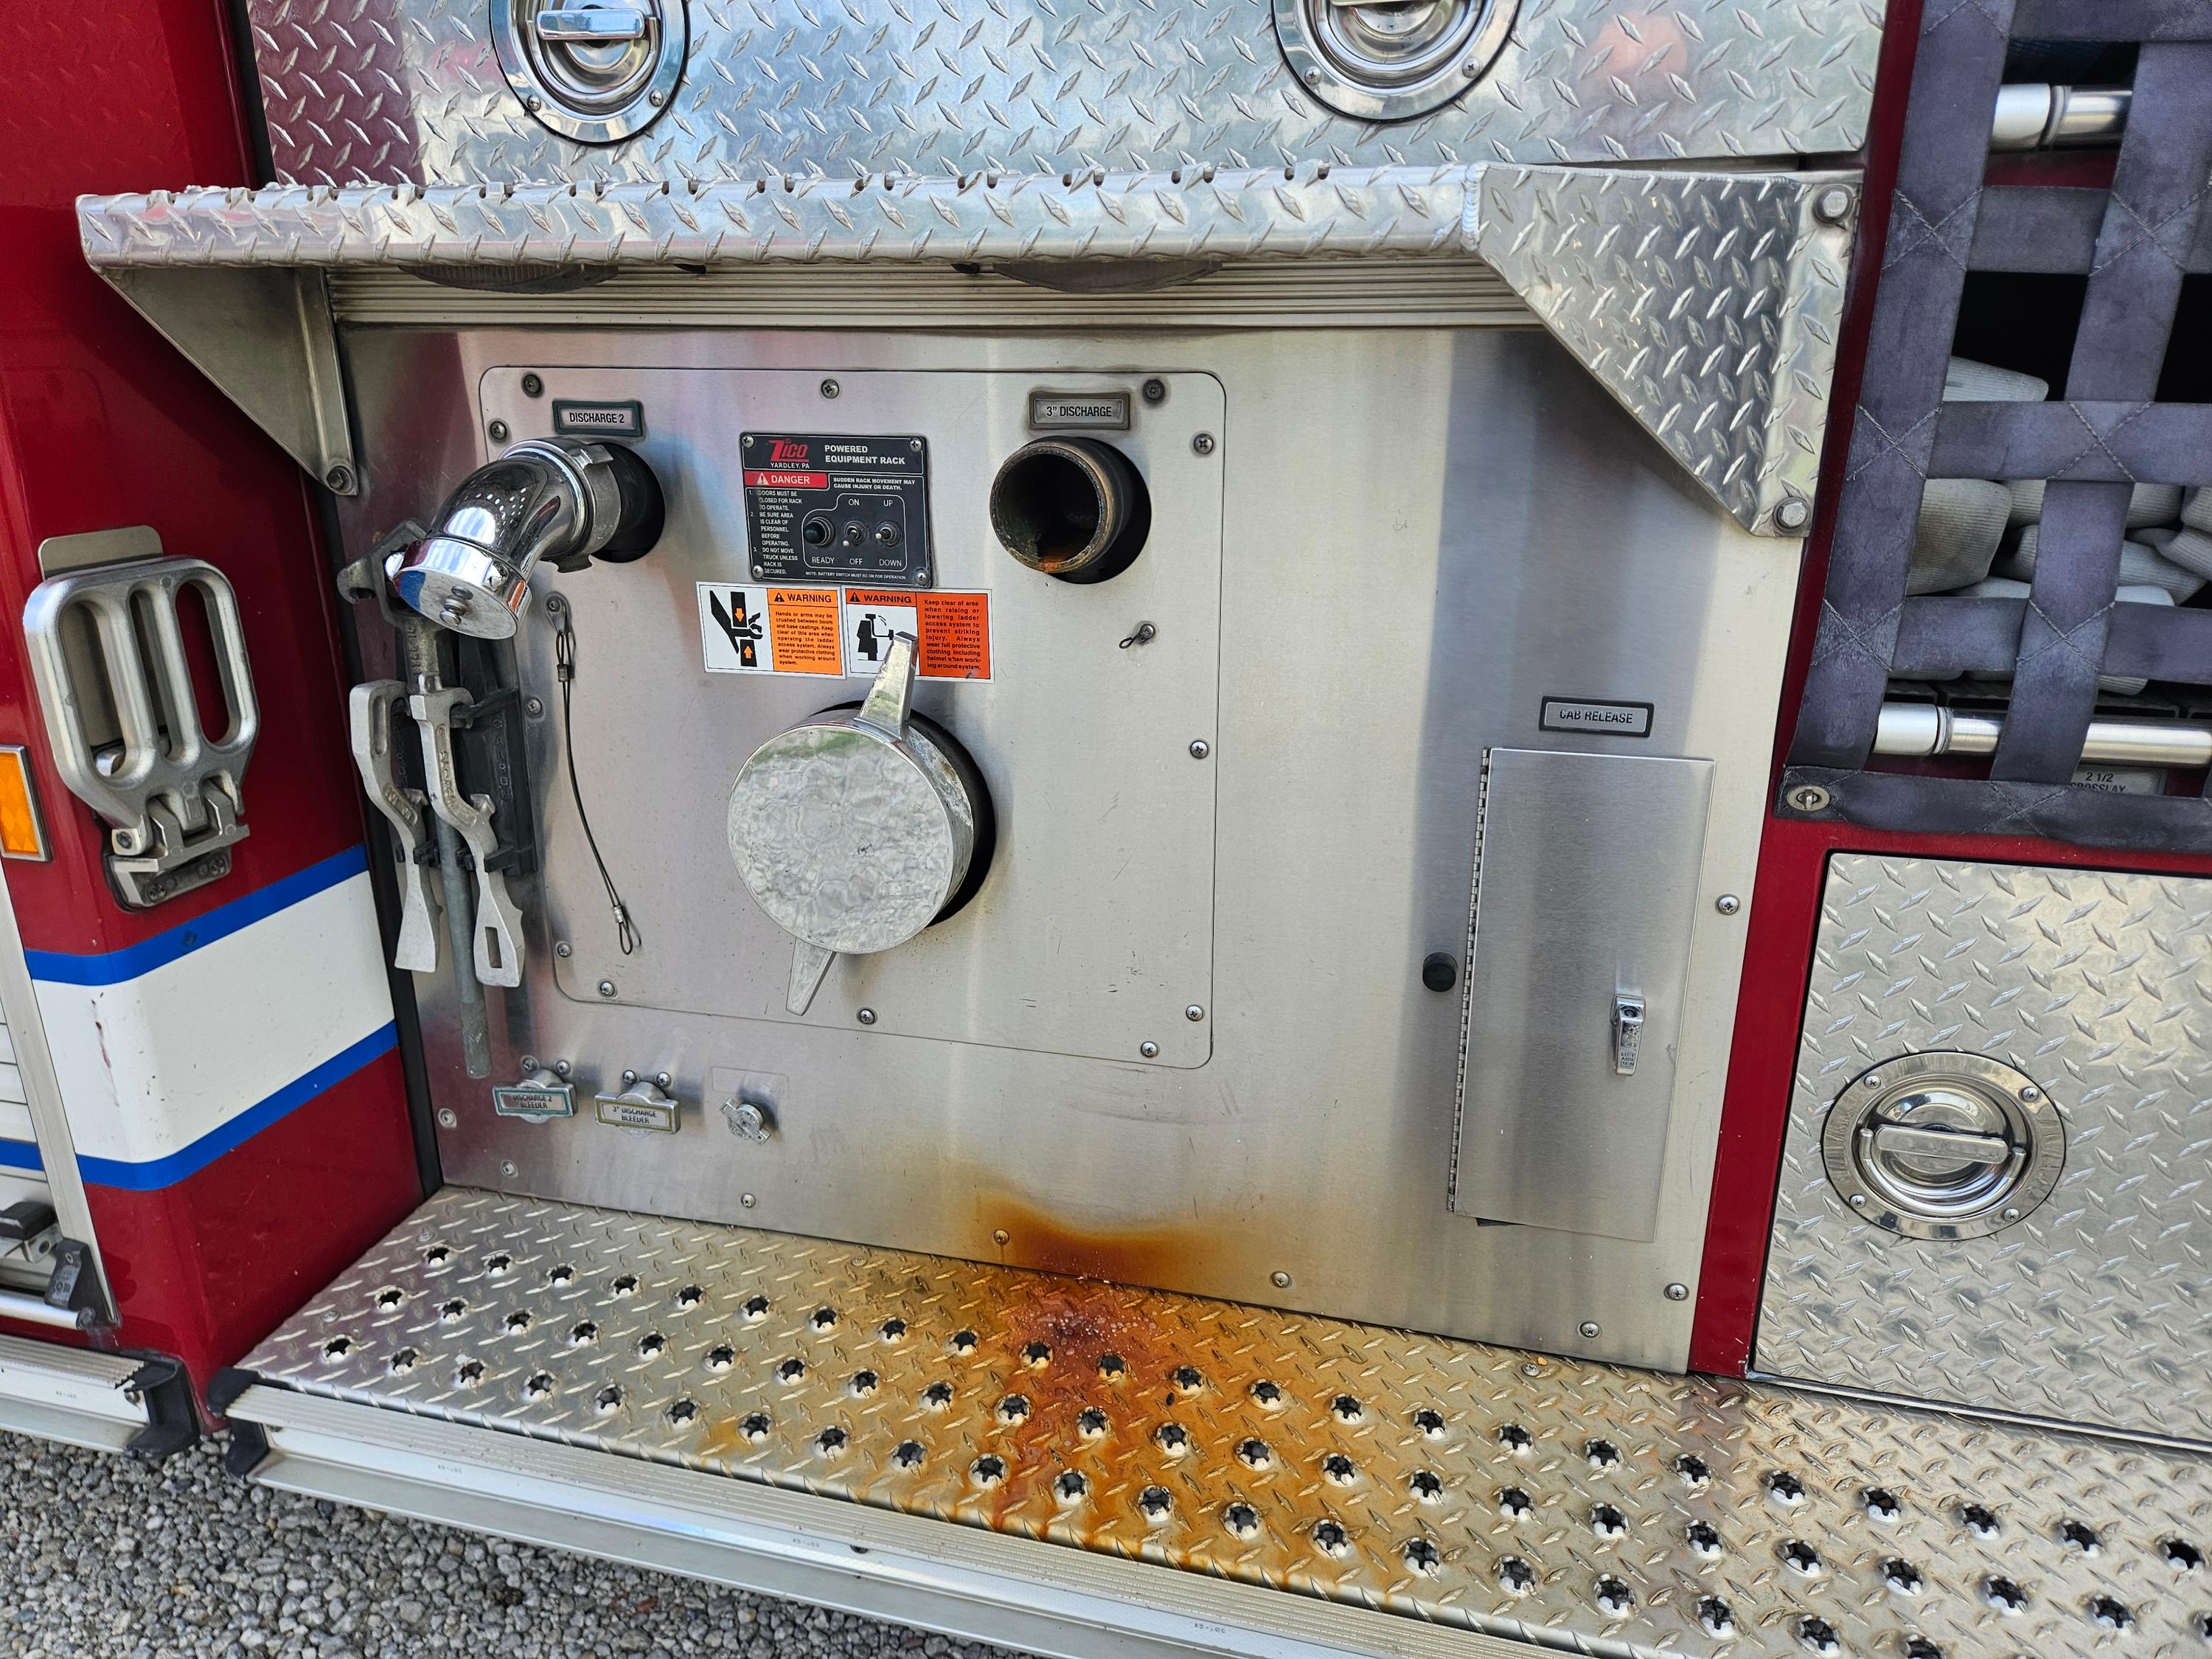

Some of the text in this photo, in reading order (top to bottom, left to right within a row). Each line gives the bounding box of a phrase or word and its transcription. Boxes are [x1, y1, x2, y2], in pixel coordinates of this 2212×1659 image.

[1060, 406, 1112, 417] DISCHARGE
[569, 412, 625, 423] DISCHARGE 2
[824, 445, 869, 453] POWERED
[825, 455, 905, 465] EQUIPMENT RACK
[771, 475, 810, 484] DANGER
[848, 498, 860, 507] ON
[812, 556, 835, 564] READY
[879, 559, 902, 567] DOWN
[787, 594, 832, 603] WARNING
[863, 594, 911, 603] WARNING
[1559, 709, 1633, 724] CAB RELEASE
[2085, 771, 2114, 782] 2 1/2
[622, 1107, 657, 1118] DISCHARGE
[622, 1115, 650, 1124] BLEEDER
